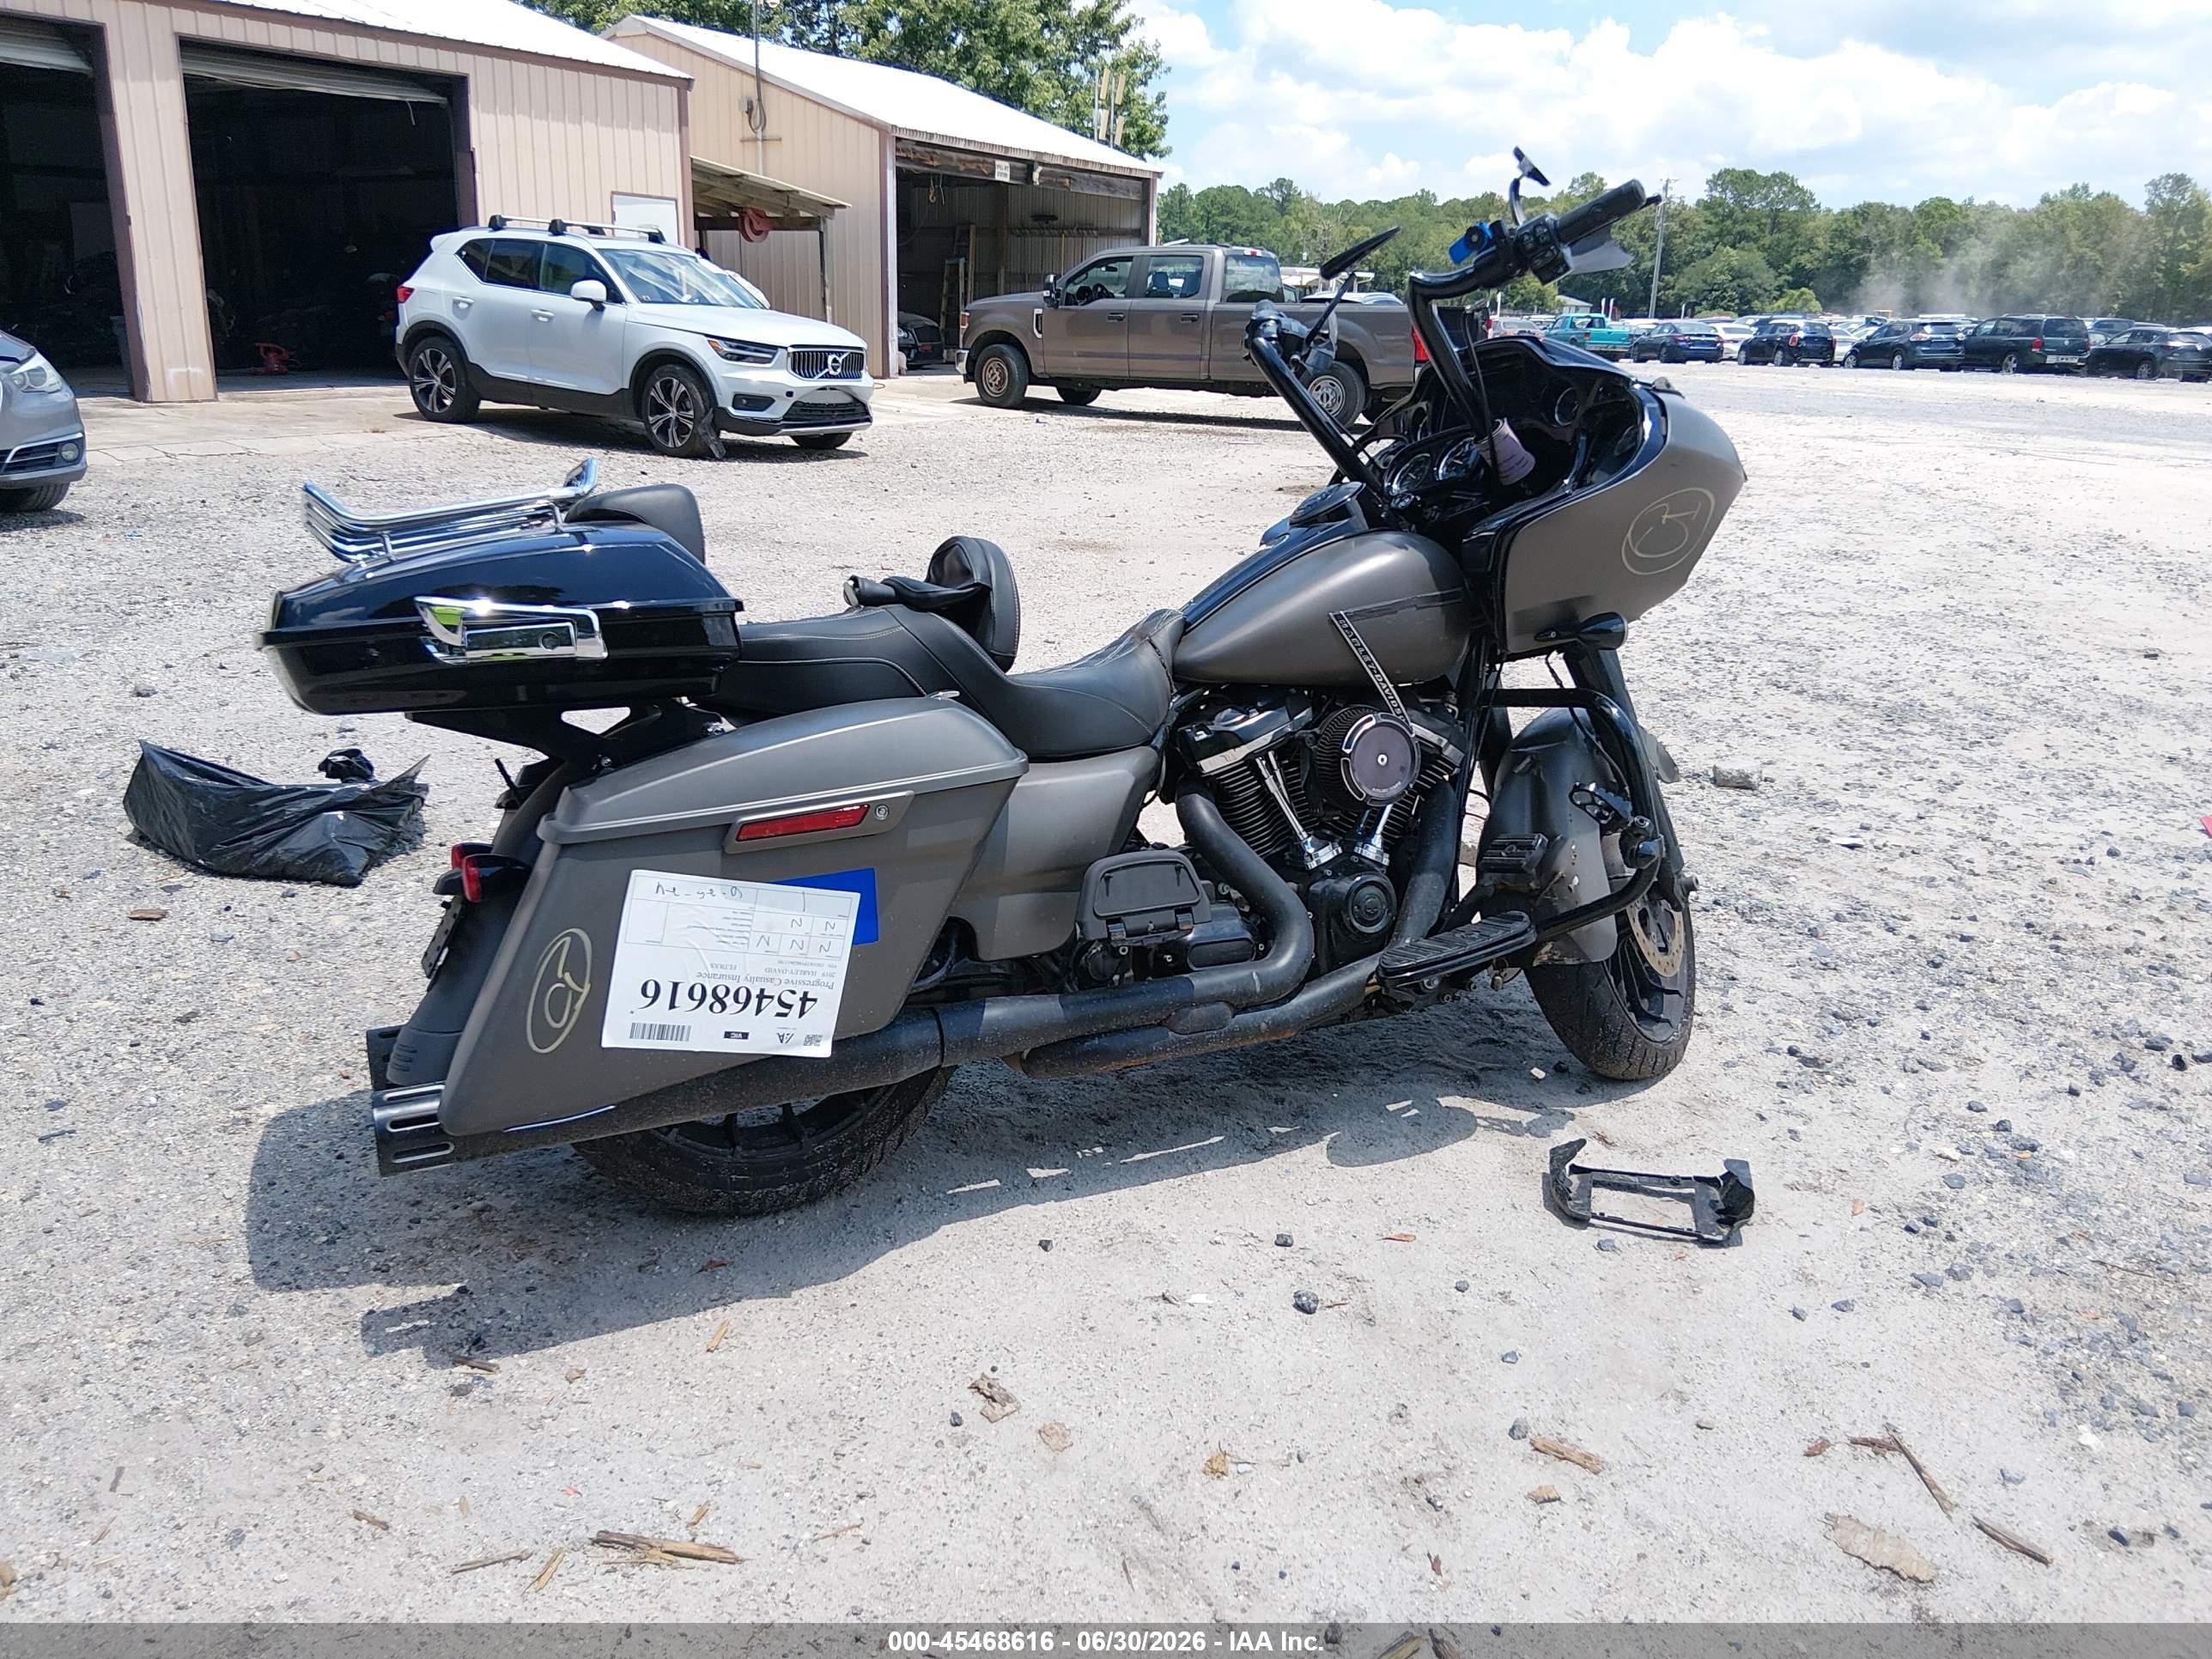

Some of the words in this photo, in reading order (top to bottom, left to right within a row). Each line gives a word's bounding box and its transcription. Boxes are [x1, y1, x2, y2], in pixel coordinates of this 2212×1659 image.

[1336, 617, 1407, 722] HARLEY-DAVIDSO
[696, 971, 742, 984] Insurance
[764, 967, 817, 977] HARLEY-DAVID
[744, 974, 783, 986] Casualty
[784, 976, 836, 989] Progressive
[637, 979, 818, 1018] 45468616
